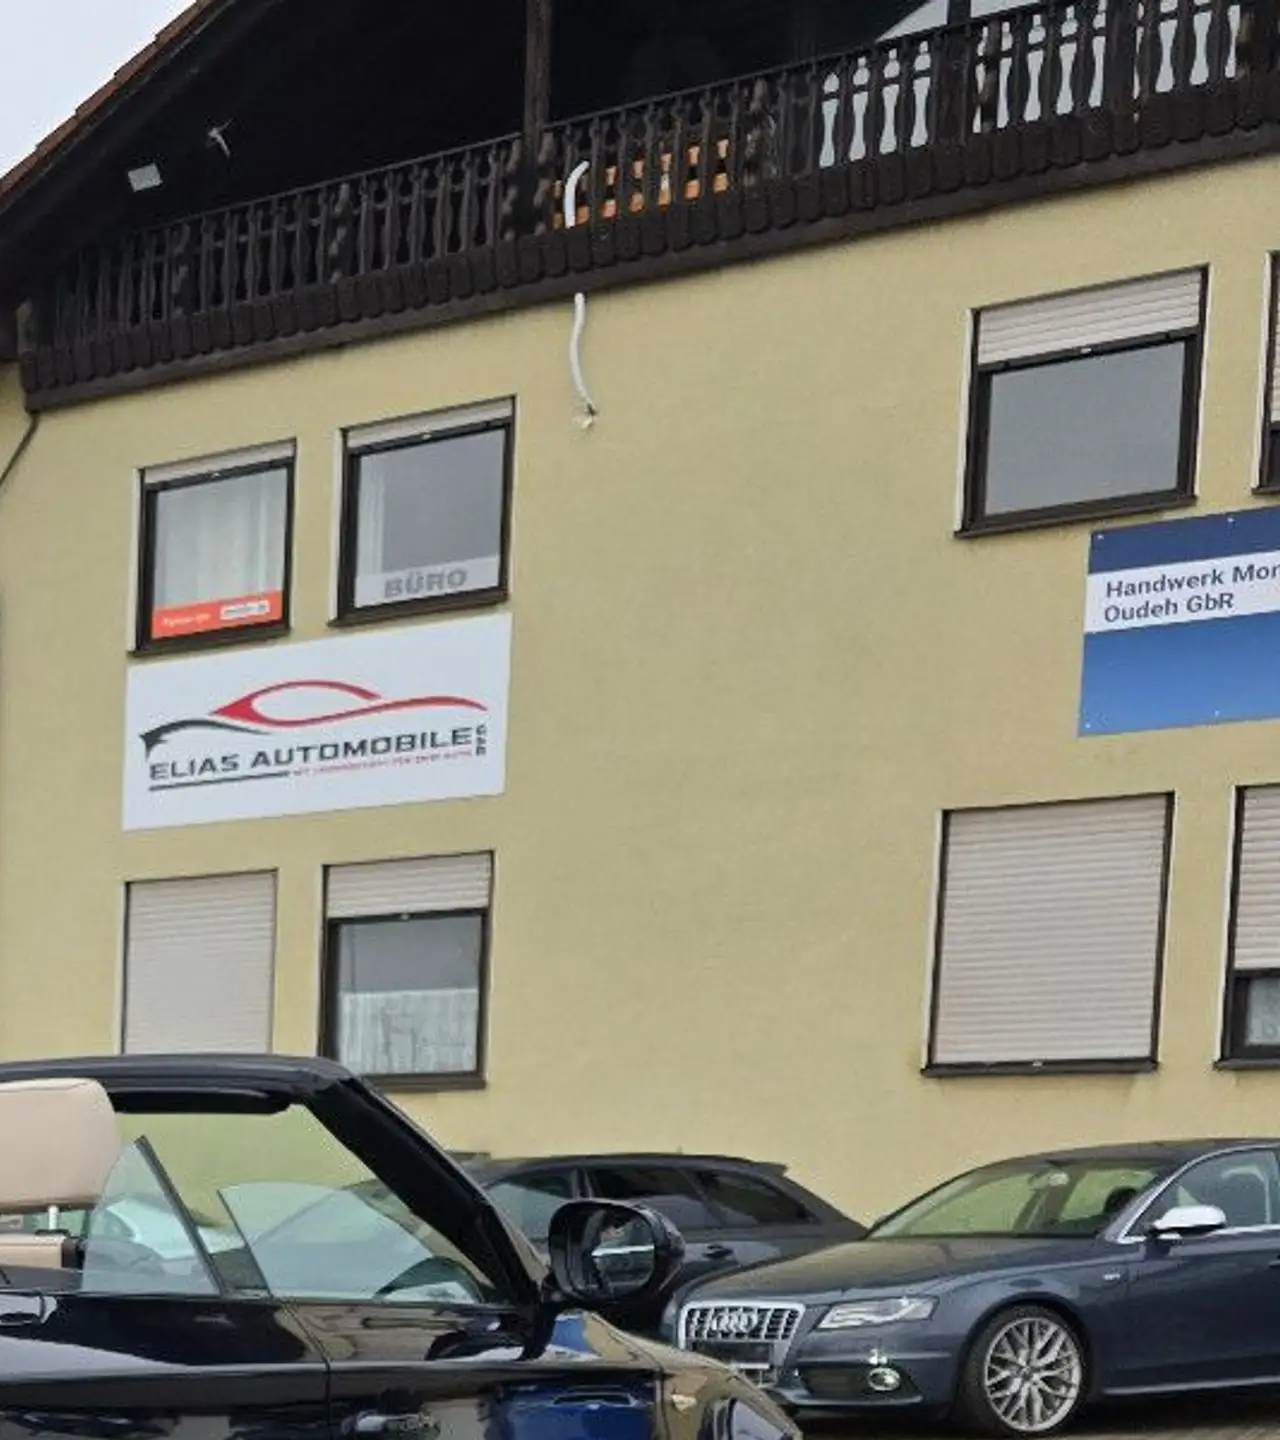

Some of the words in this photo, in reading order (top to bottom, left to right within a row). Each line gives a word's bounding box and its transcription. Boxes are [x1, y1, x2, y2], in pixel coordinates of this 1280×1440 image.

[384, 568, 467, 598] BÜRO
[1106, 569, 1224, 598] Handwerk
[1104, 598, 1178, 622] Oudeh
[1186, 592, 1235, 613] GbR
[149, 754, 240, 780] ELIAS
[250, 727, 473, 768] AUTOMOBILE
